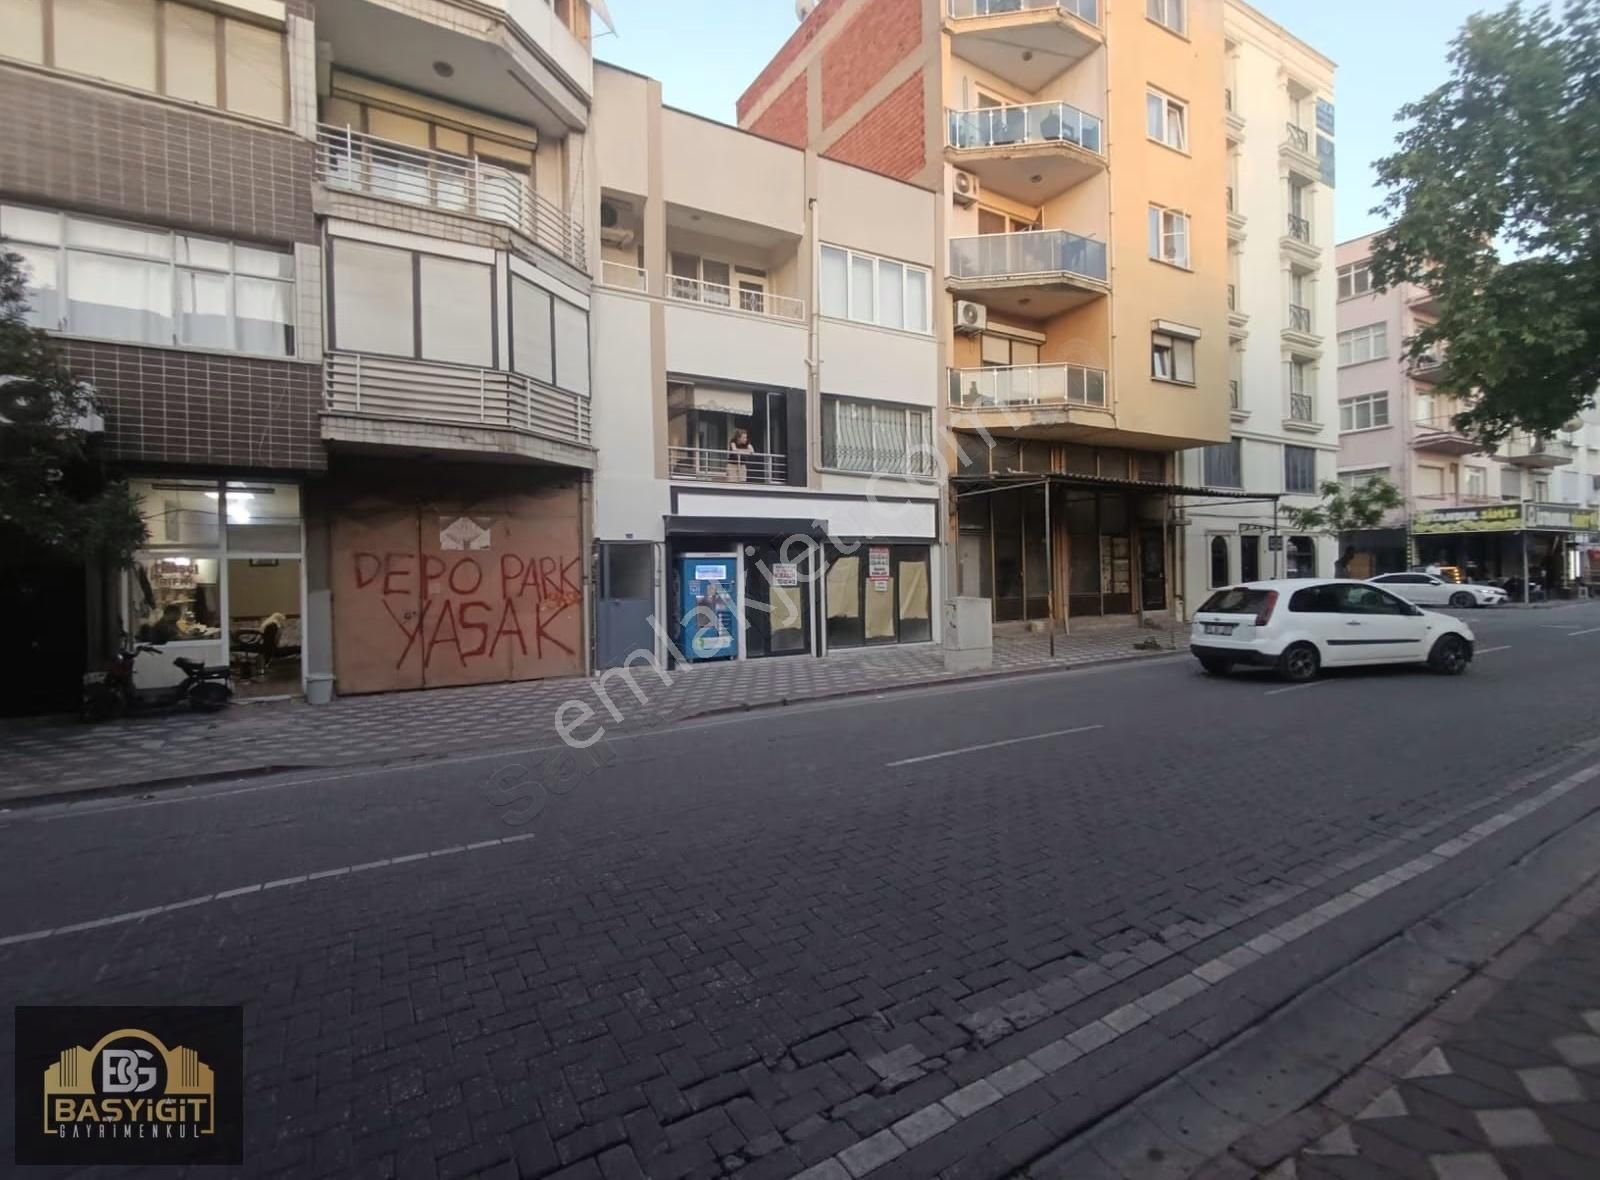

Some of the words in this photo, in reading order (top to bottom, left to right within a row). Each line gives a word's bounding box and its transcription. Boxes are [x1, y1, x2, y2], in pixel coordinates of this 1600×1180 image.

[354, 551, 482, 600] DEPO
[499, 553, 583, 601] PARK
[381, 598, 576, 670] YASAK
